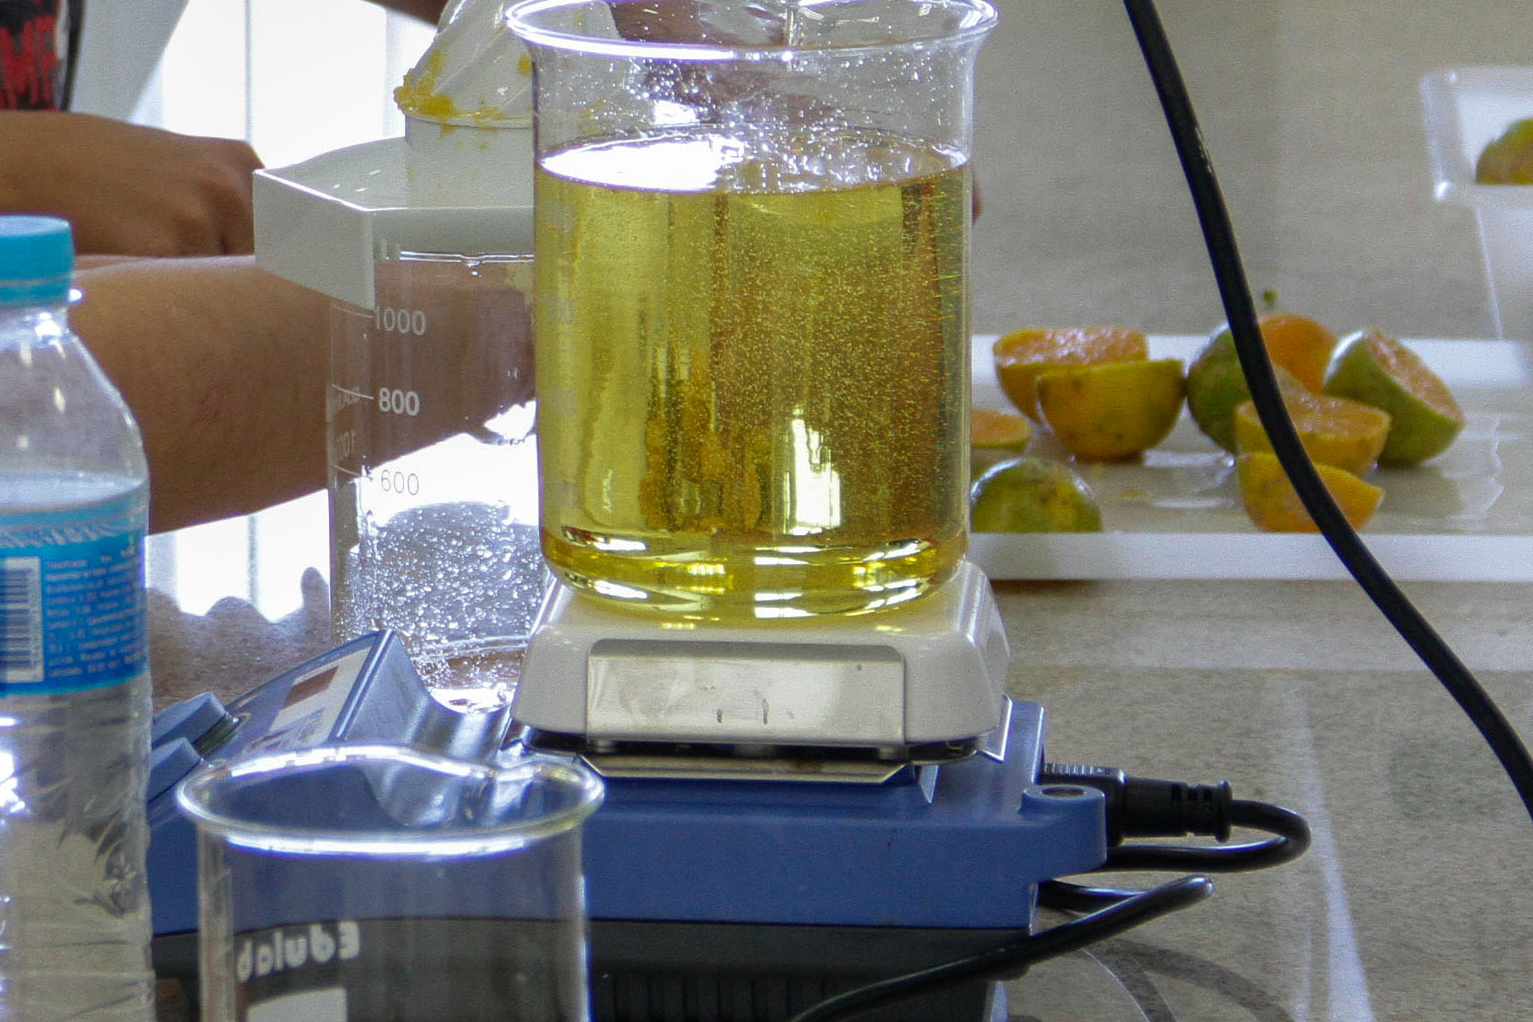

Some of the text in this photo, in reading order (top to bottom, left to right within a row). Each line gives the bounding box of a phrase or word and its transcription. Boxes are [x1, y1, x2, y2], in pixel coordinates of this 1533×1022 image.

[374, 306, 427, 336] 1000
[378, 387, 420, 416] 800
[380, 469, 420, 496] 600
